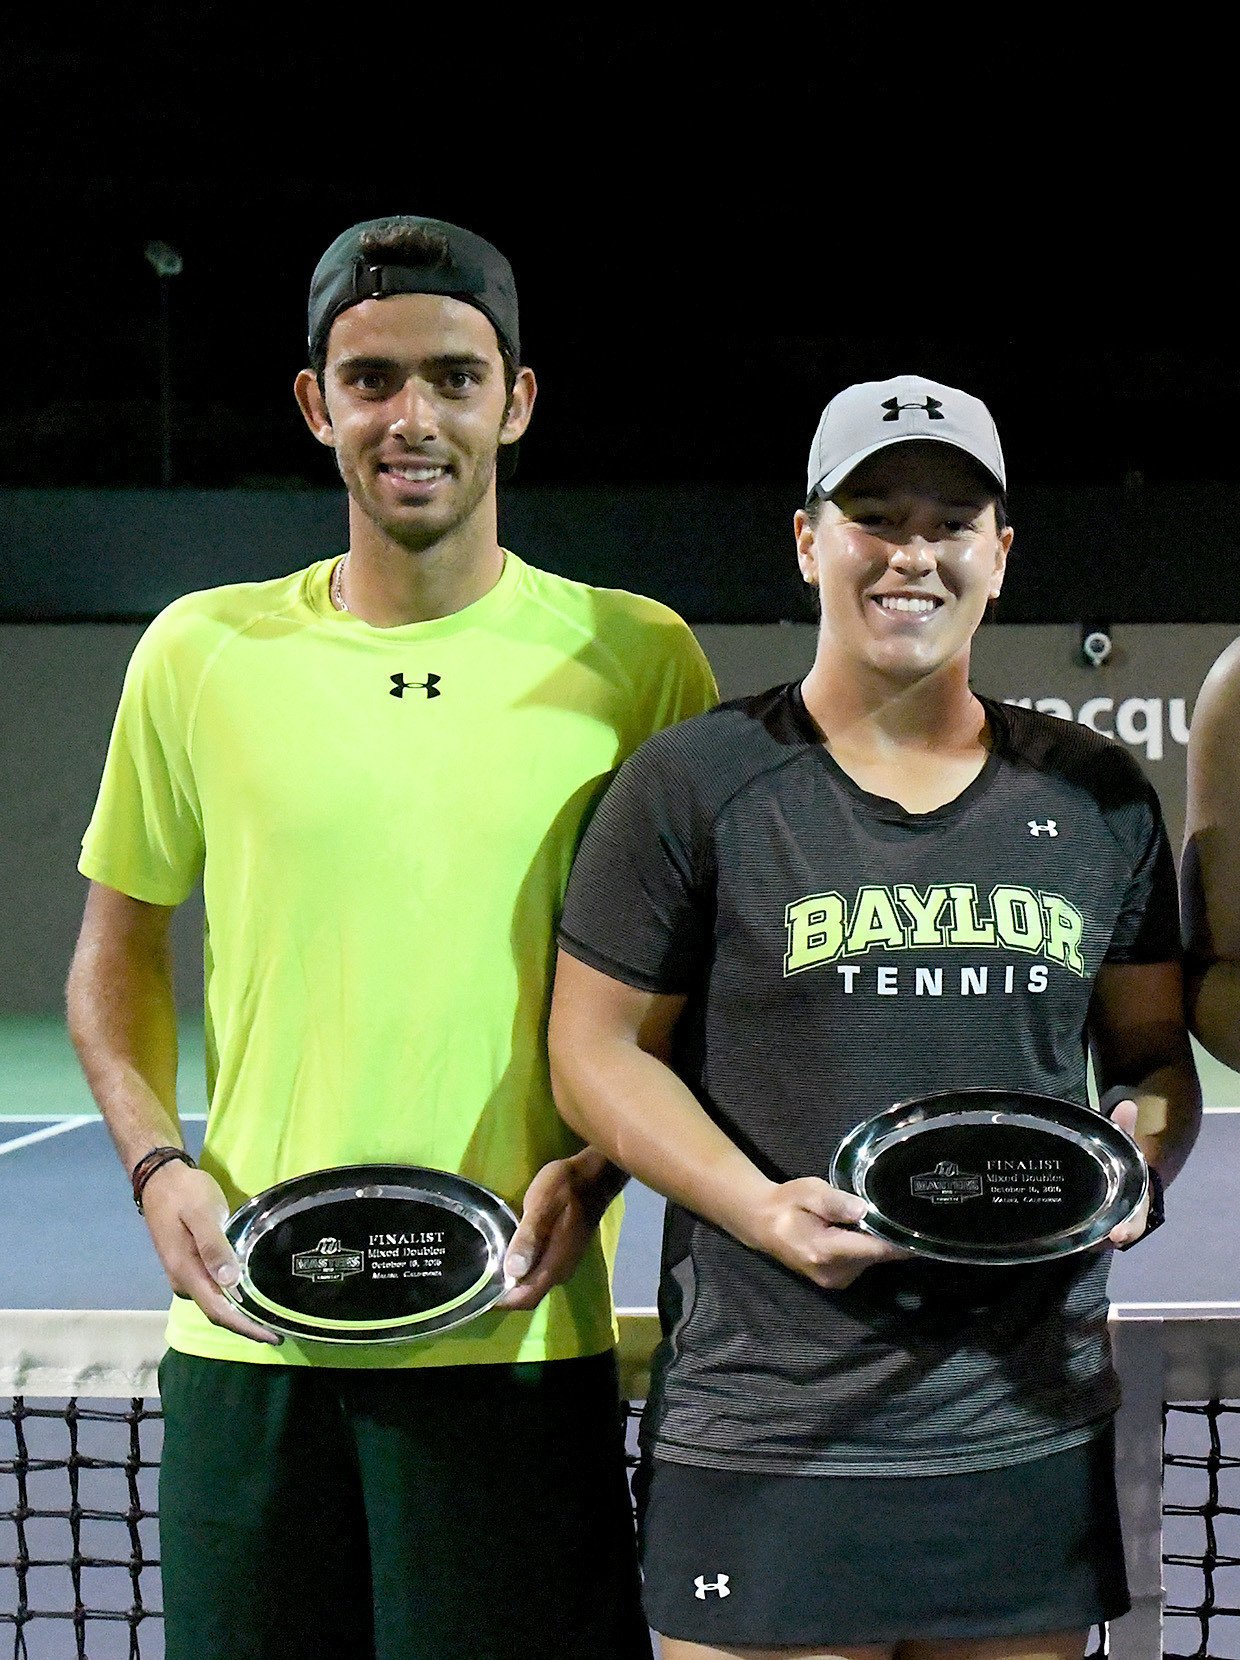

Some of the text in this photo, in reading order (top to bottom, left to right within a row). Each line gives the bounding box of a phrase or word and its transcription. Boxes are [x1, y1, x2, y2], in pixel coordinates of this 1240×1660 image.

[783, 883, 1085, 978] BAYLOR
[837, 965, 1049, 996] TENNIS
[987, 1160, 1062, 1170] FINALIST
[986, 1173, 1065, 1183] Mixed Doubles
[369, 1232, 445, 1246] FINALIST
[368, 1246, 446, 1258] Mixed Doubles
[371, 1261, 407, 1269] October
